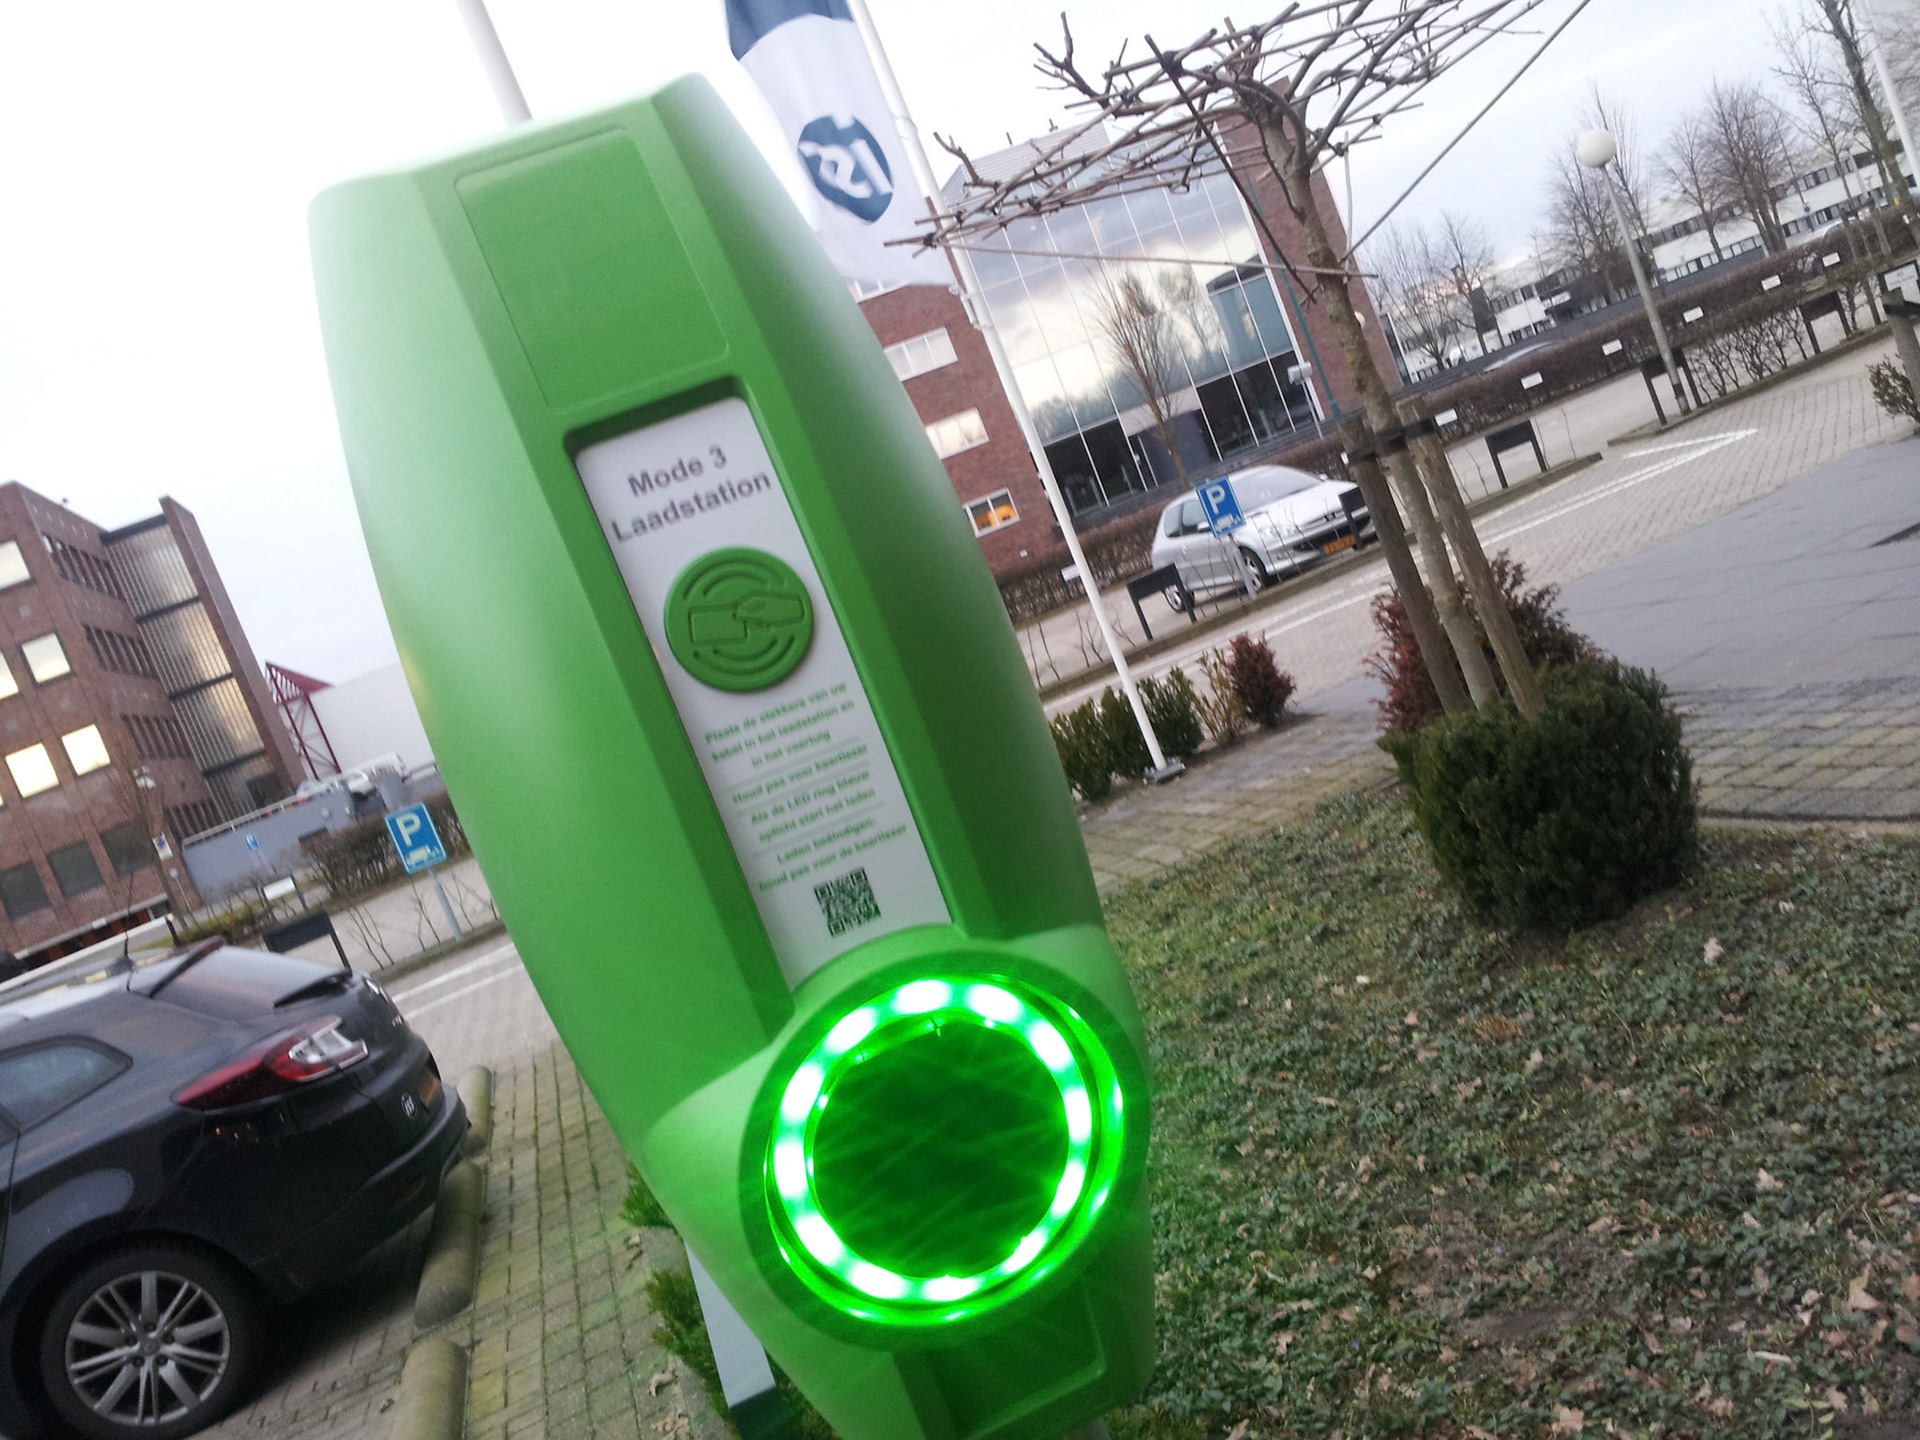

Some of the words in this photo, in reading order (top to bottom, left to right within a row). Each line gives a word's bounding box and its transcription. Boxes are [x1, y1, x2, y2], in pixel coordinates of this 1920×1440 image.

[627, 457, 704, 498] Mode
[709, 444, 728, 469] 3
[610, 471, 772, 543] Laadstation
[1205, 484, 1226, 515] P
[758, 729, 776, 744] het
[765, 749, 783, 763] het
[396, 811, 421, 847] P
